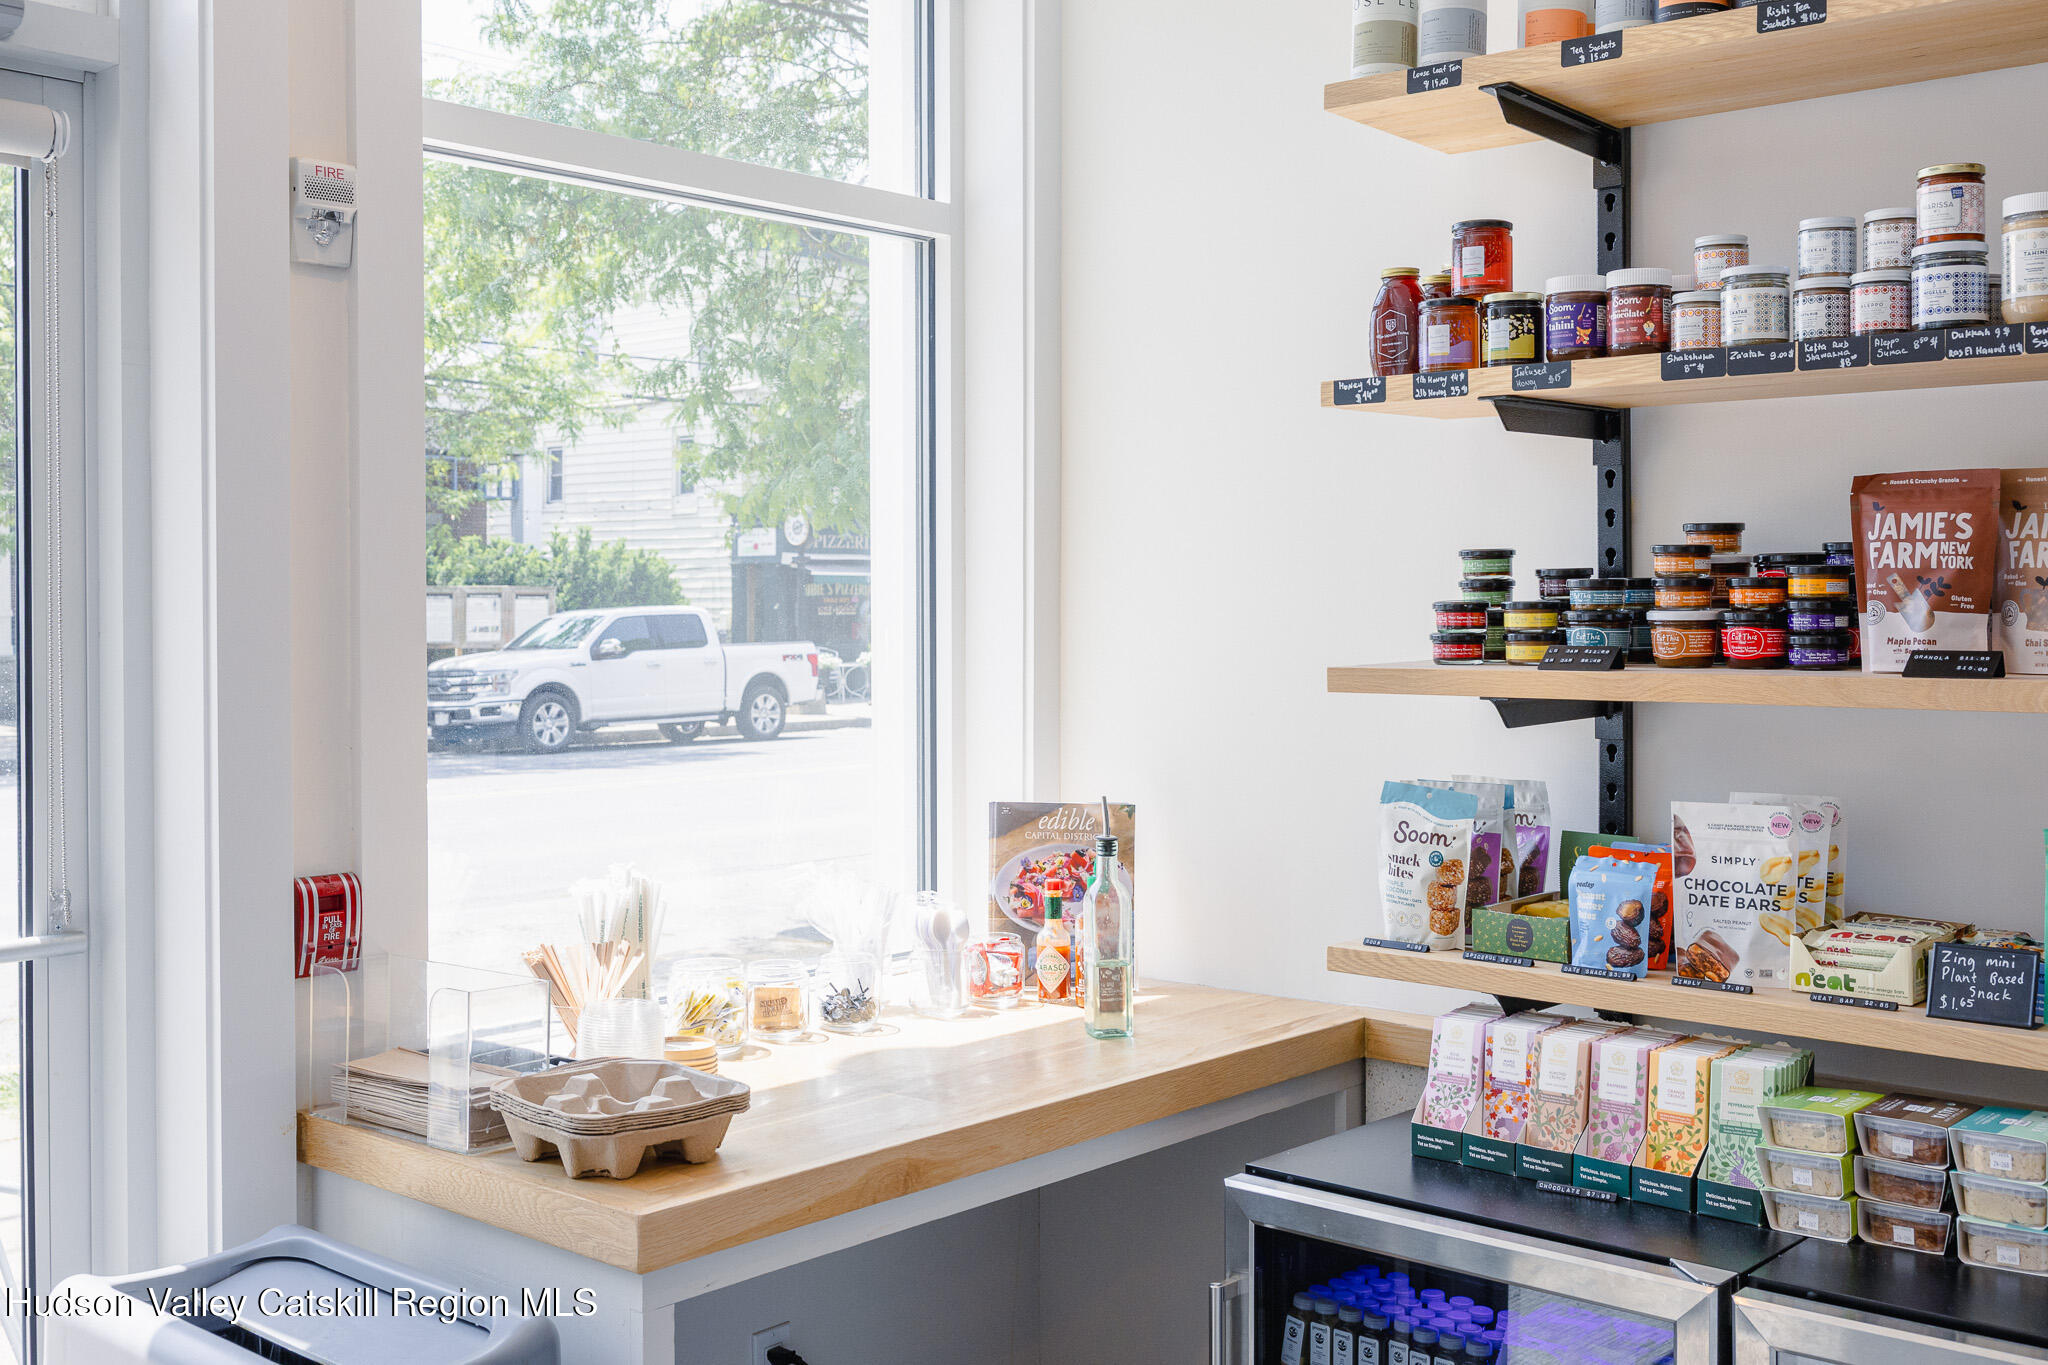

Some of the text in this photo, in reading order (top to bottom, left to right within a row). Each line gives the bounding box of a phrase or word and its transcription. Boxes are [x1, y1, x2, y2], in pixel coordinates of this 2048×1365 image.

[1766, 2, 1811, 17] Rishi Tea
[1570, 45, 1585, 56] Tea
[1448, 63, 1462, 72] Tea
[315, 165, 345, 180] FIRE
[1549, 303, 1575, 315] Soom
[1549, 319, 1575, 331] tahini
[1951, 327, 1991, 340] Dukkah
[1514, 365, 1547, 378] Infused
[1339, 381, 1364, 393] Honey
[1889, 478, 1909, 486] Honest
[1914, 477, 1938, 486] Crunchy
[1867, 511, 1974, 541] JAMIE'S
[1939, 541, 1971, 555] NEW
[2009, 540, 2048, 569] FAR
[1869, 541, 1938, 570] FARM
[1939, 555, 1974, 570] YORK
[1588, 632, 1601, 640] This
[1742, 632, 1758, 641] This
[1886, 637, 1937, 648] Maple Pecan
[2025, 638, 2041, 647] Chai
[1038, 807, 1096, 832] edible
[1024, 831, 1099, 841] CAPITAL DISTRIC
[1393, 820, 1453, 848] Soom
[1388, 853, 1421, 867] snack
[1711, 855, 1756, 866] SIMPLY
[1388, 862, 1414, 880] bites
[1684, 877, 1788, 897] CHOCOLATE
[1688, 893, 1781, 912] DATE BARS
[323, 915, 342, 924] PULL
[1712, 918, 1752, 927] SALTED PEANUT
[323, 932, 340, 941] FIRE
[1941, 950, 2016, 971] Zing mini
[1564, 966, 1581, 974] DATE
[1941, 966, 2025, 985] Plant Based
[1812, 994, 1854, 1005] NEAT BAR
[1969, 985, 2012, 1001] Snack
[1939, 995, 1974, 1011] $1.65
[1539, 1181, 1581, 1195] CHOCOLATE
[1705, 1192, 1727, 1202] Delicious.
[1719, 1202, 1737, 1211] Simple.
